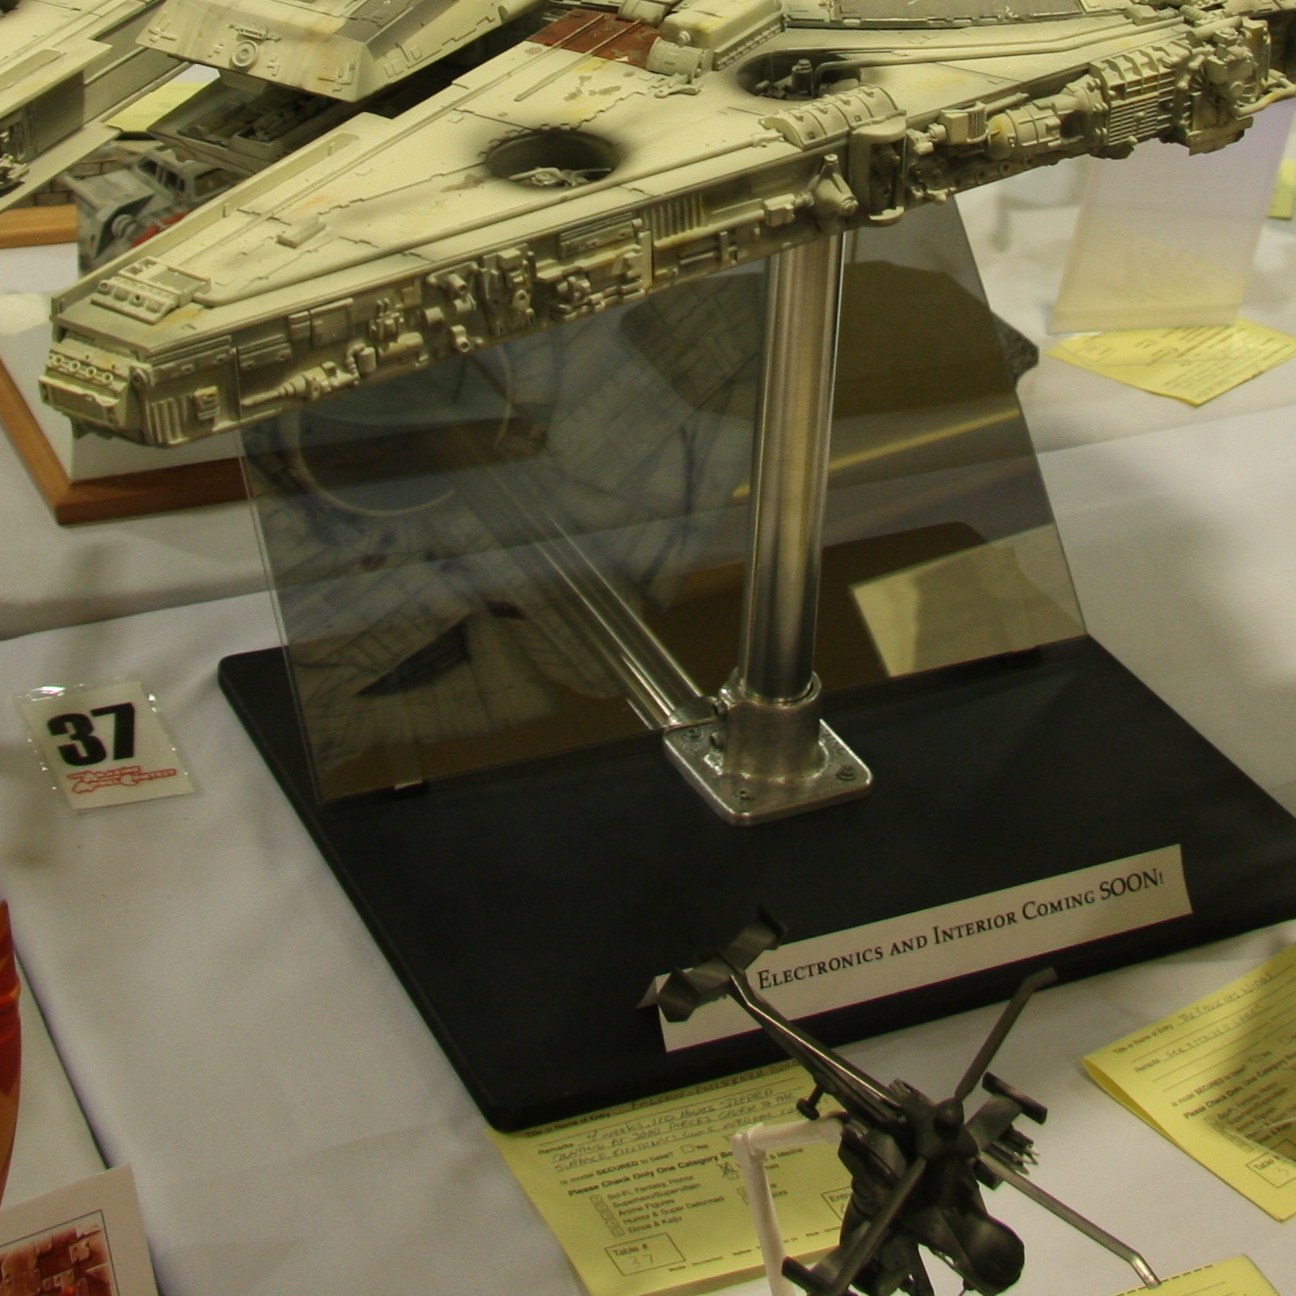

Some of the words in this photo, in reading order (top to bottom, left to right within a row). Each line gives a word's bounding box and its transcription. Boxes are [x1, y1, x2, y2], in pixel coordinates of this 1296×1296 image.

[47, 702, 135, 766] 37
[757, 943, 884, 990] ELECTRONICS
[889, 934, 928, 957] AND
[932, 909, 1018, 946] INTERIOR
[1021, 889, 1095, 922] COMING
[1099, 867, 1164, 901] SOON!
[568, 1183, 599, 1196] Please
[601, 1176, 630, 1188] Check
[632, 1170, 655, 1182] Only
[657, 1164, 676, 1174] One
[679, 1154, 719, 1170] Category
[596, 1161, 639, 1176] SECURED
[614, 1247, 640, 1257] Table
